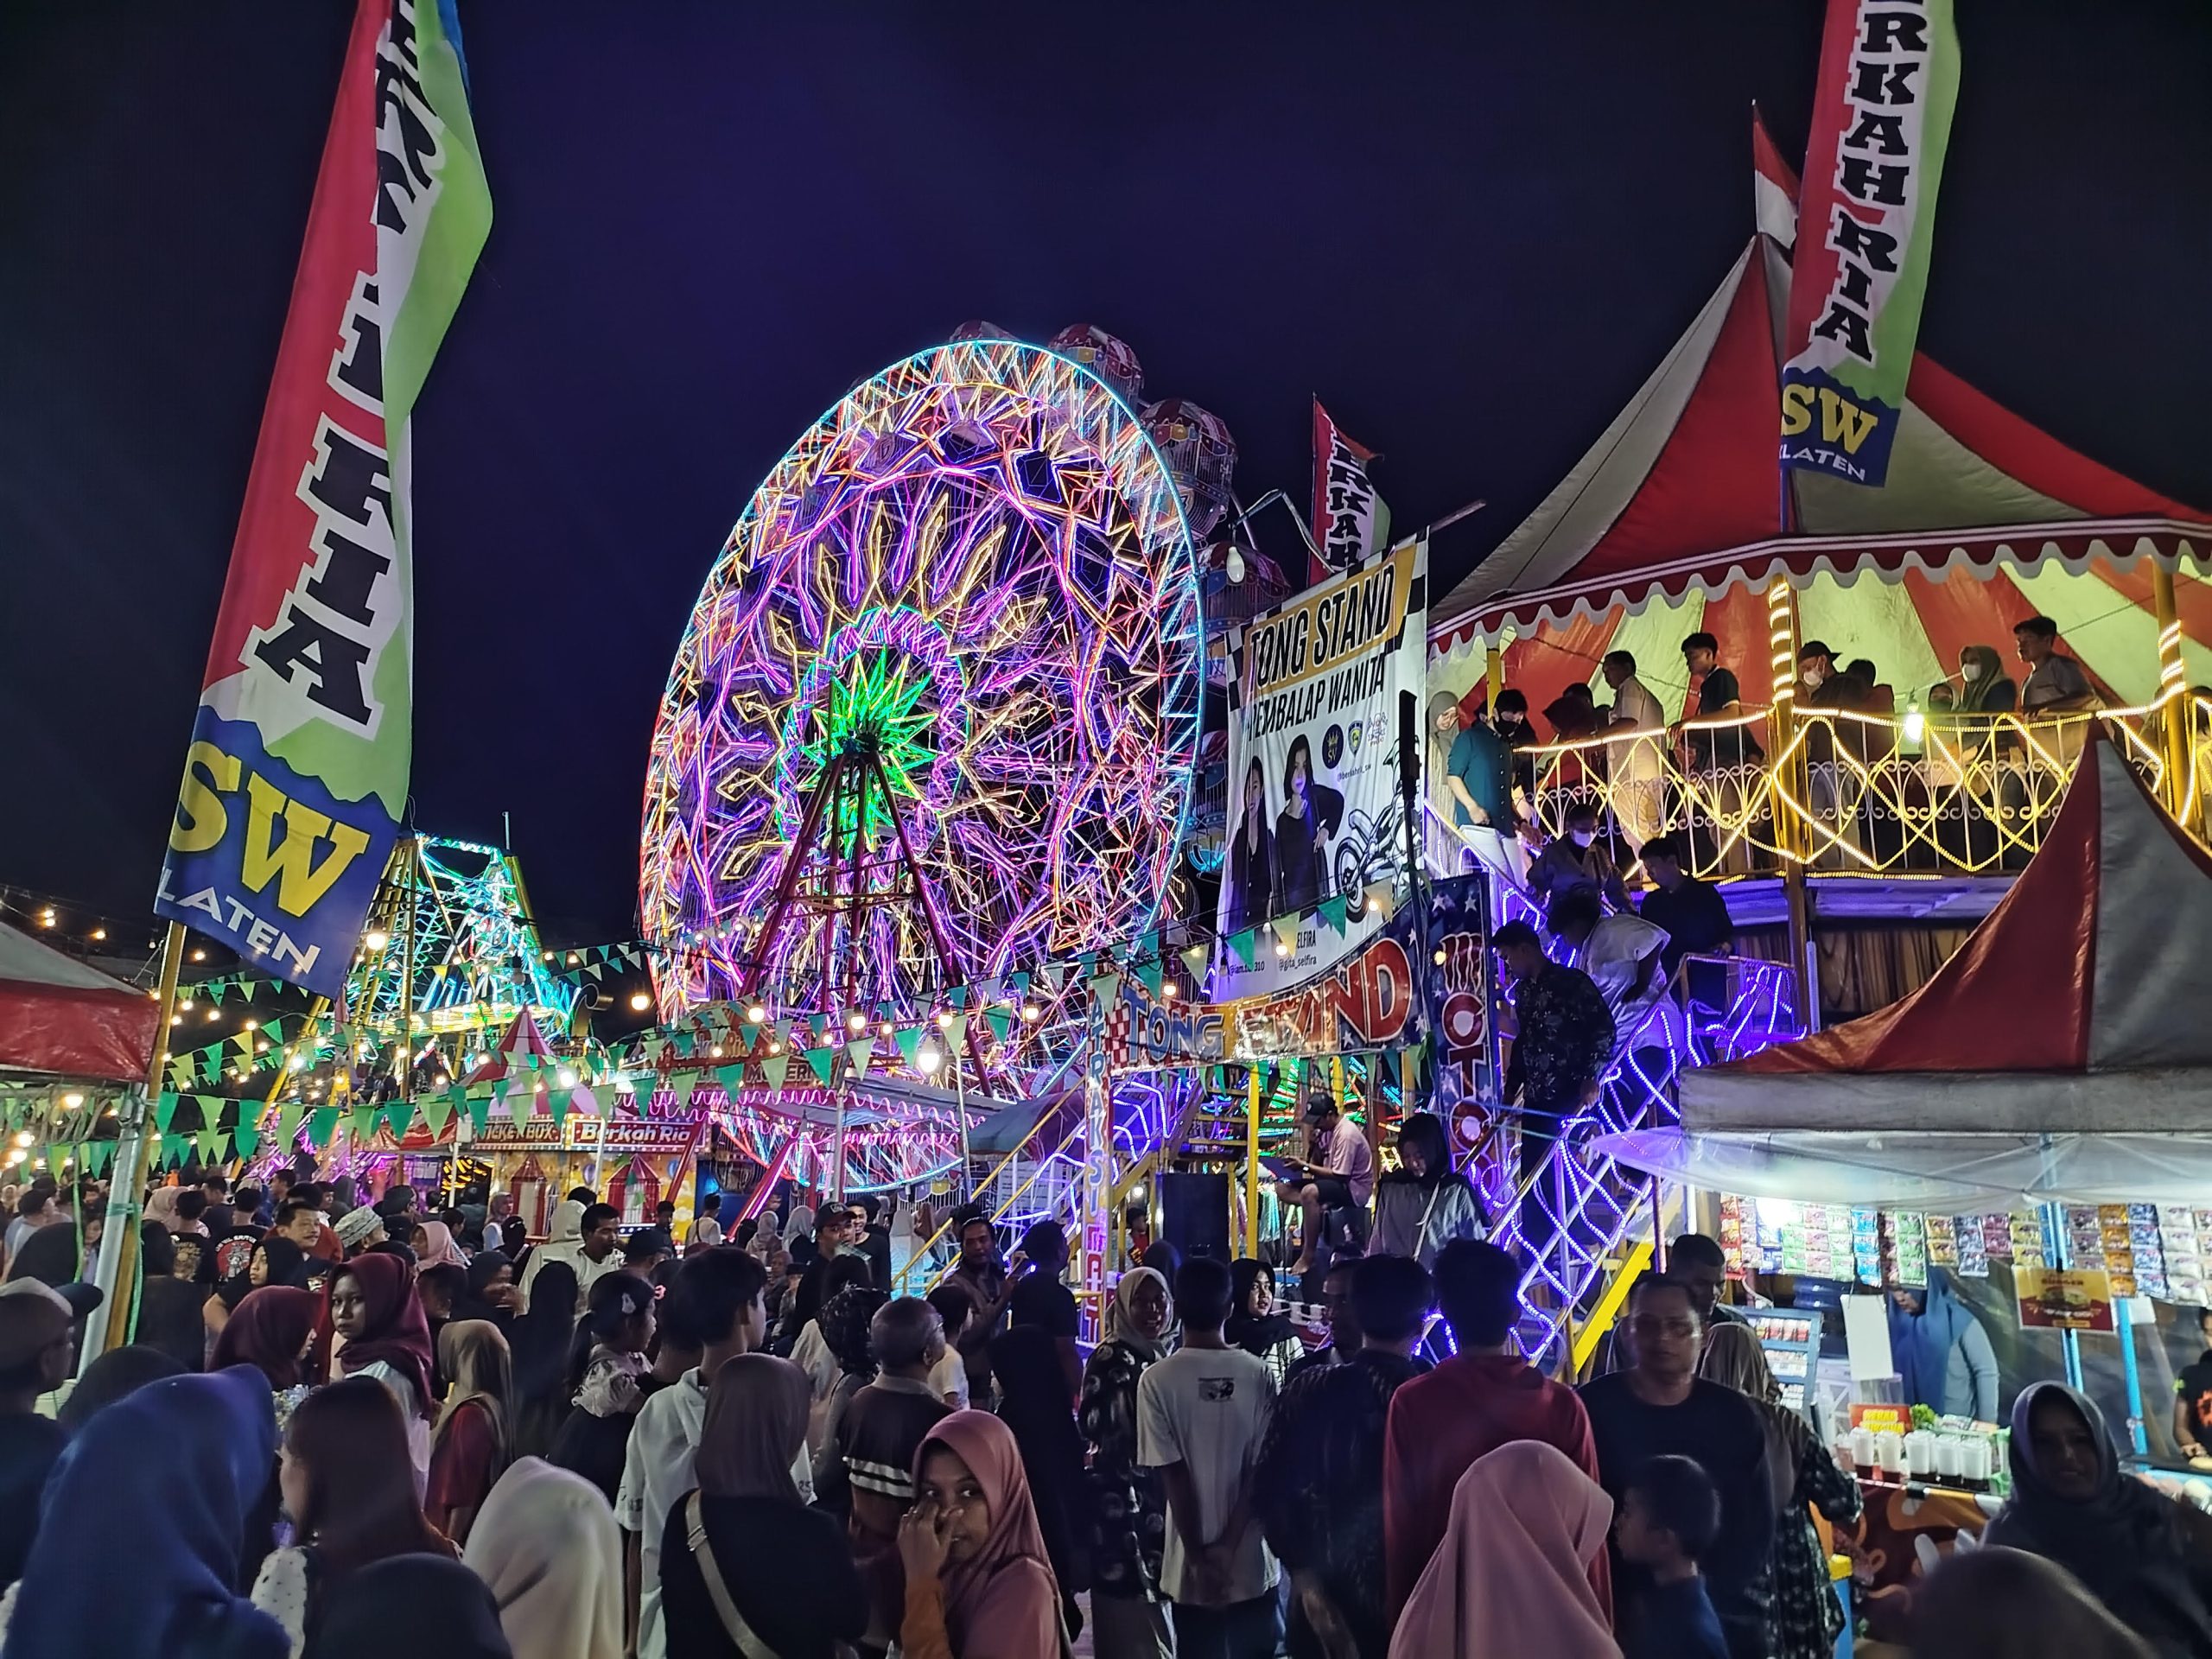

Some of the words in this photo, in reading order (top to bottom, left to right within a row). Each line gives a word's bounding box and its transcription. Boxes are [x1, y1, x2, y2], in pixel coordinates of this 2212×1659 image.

[1815, 0, 1928, 363] RKAHRIA
[1779, 443, 1866, 481] LATEN
[1781, 384, 1878, 454] SW
[1250, 607, 1310, 690] TONG
[1313, 561, 1396, 668] STAND
[1248, 679, 1326, 741] PEMBALAP
[1328, 652, 1386, 715] WANITA
[169, 740, 371, 918] SW
[1123, 983, 1224, 1065] TONG
[1237, 938, 1413, 1052] STAND
[526, 1122, 554, 1142] BOX
[1088, 995, 1107, 1218] ATRAKSI
